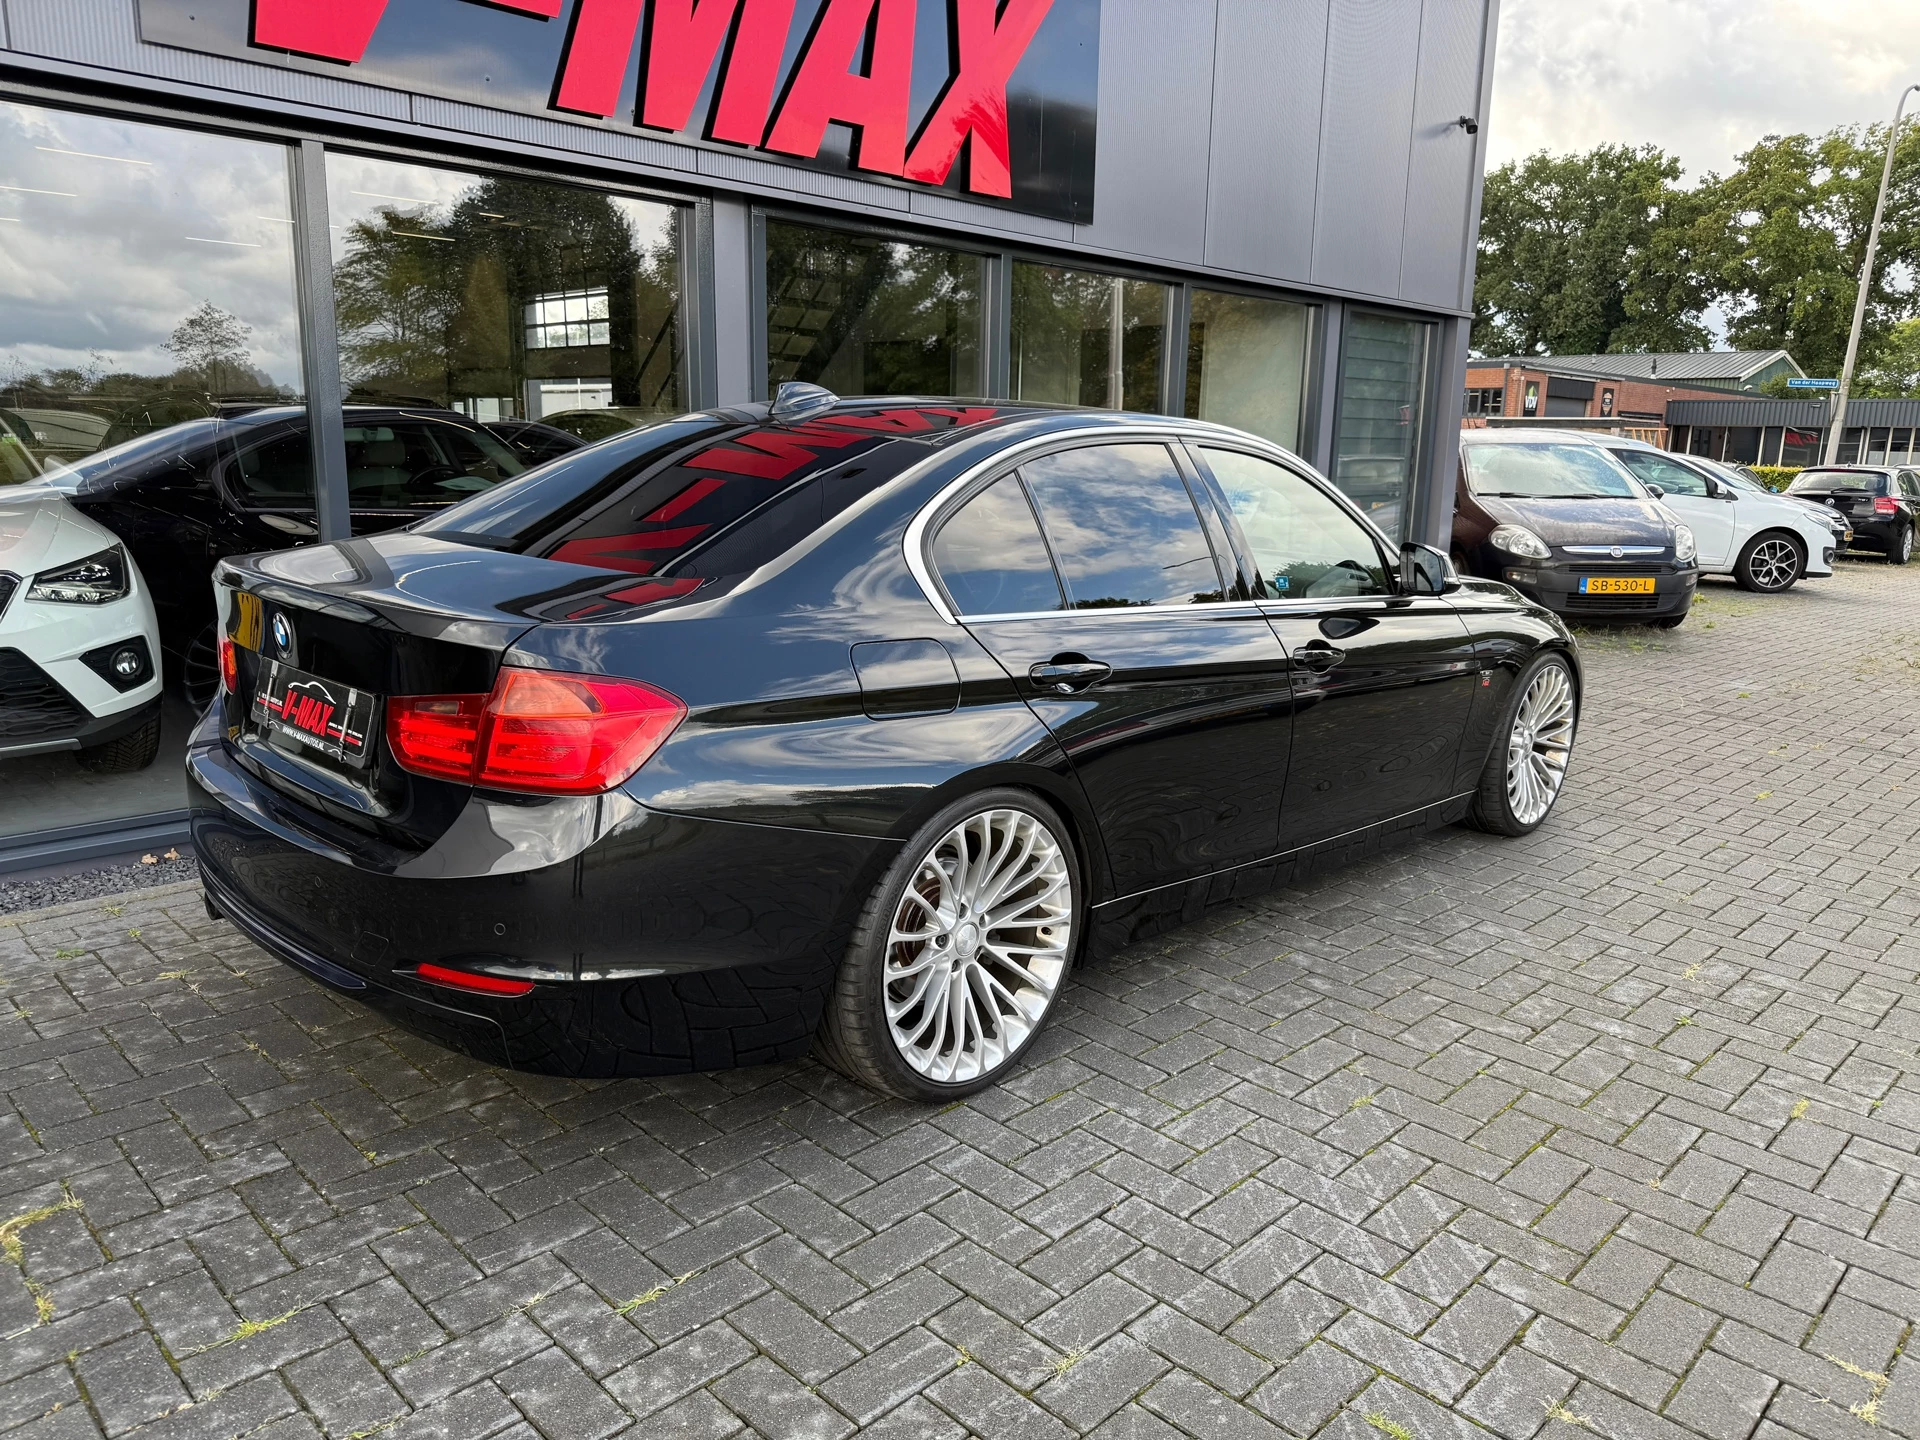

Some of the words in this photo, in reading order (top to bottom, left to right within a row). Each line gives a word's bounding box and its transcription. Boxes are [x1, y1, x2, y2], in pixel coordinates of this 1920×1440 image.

[252, 0, 1054, 198] MAX
[1591, 580, 1650, 591] SB-530-L
[281, 690, 335, 737] V-MAX
